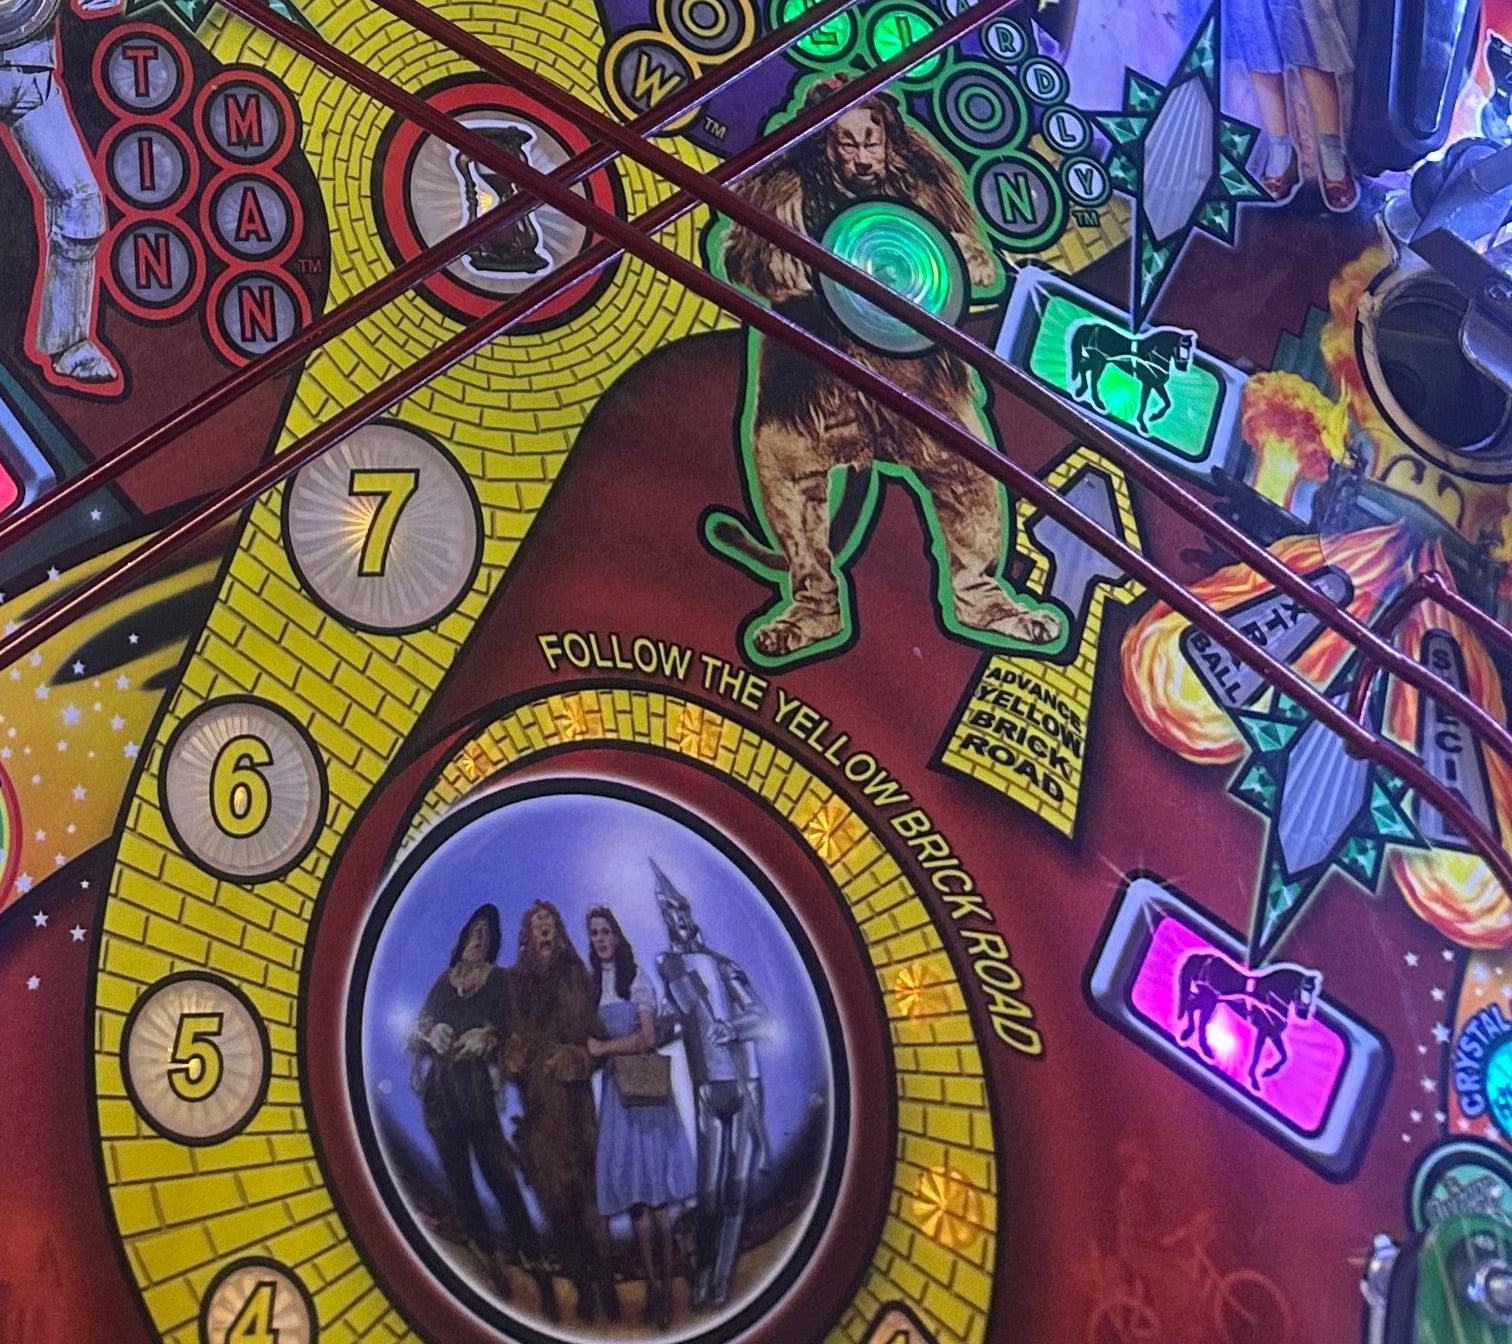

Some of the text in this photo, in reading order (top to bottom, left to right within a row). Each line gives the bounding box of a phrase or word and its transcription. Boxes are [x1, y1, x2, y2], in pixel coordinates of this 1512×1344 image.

[121, 43, 175, 292] TIN
[223, 92, 280, 344] MAN
[347, 466, 422, 579] 7
[985, 664, 1083, 734] ADVANCE
[1190, 631, 1244, 704] BALL
[958, 732, 1066, 804] ROAD
[969, 708, 1073, 785] BRICK
[976, 684, 1085, 759] YELLOW
[207, 733, 274, 838] 6
[536, 631, 1044, 1059] FOLLOW THE YELLOW BRICK ROAD
[167, 1011, 226, 1105] 5
[1454, 1005, 1511, 1118] CRYSTAL
[228, 1280, 282, 1344] 4
